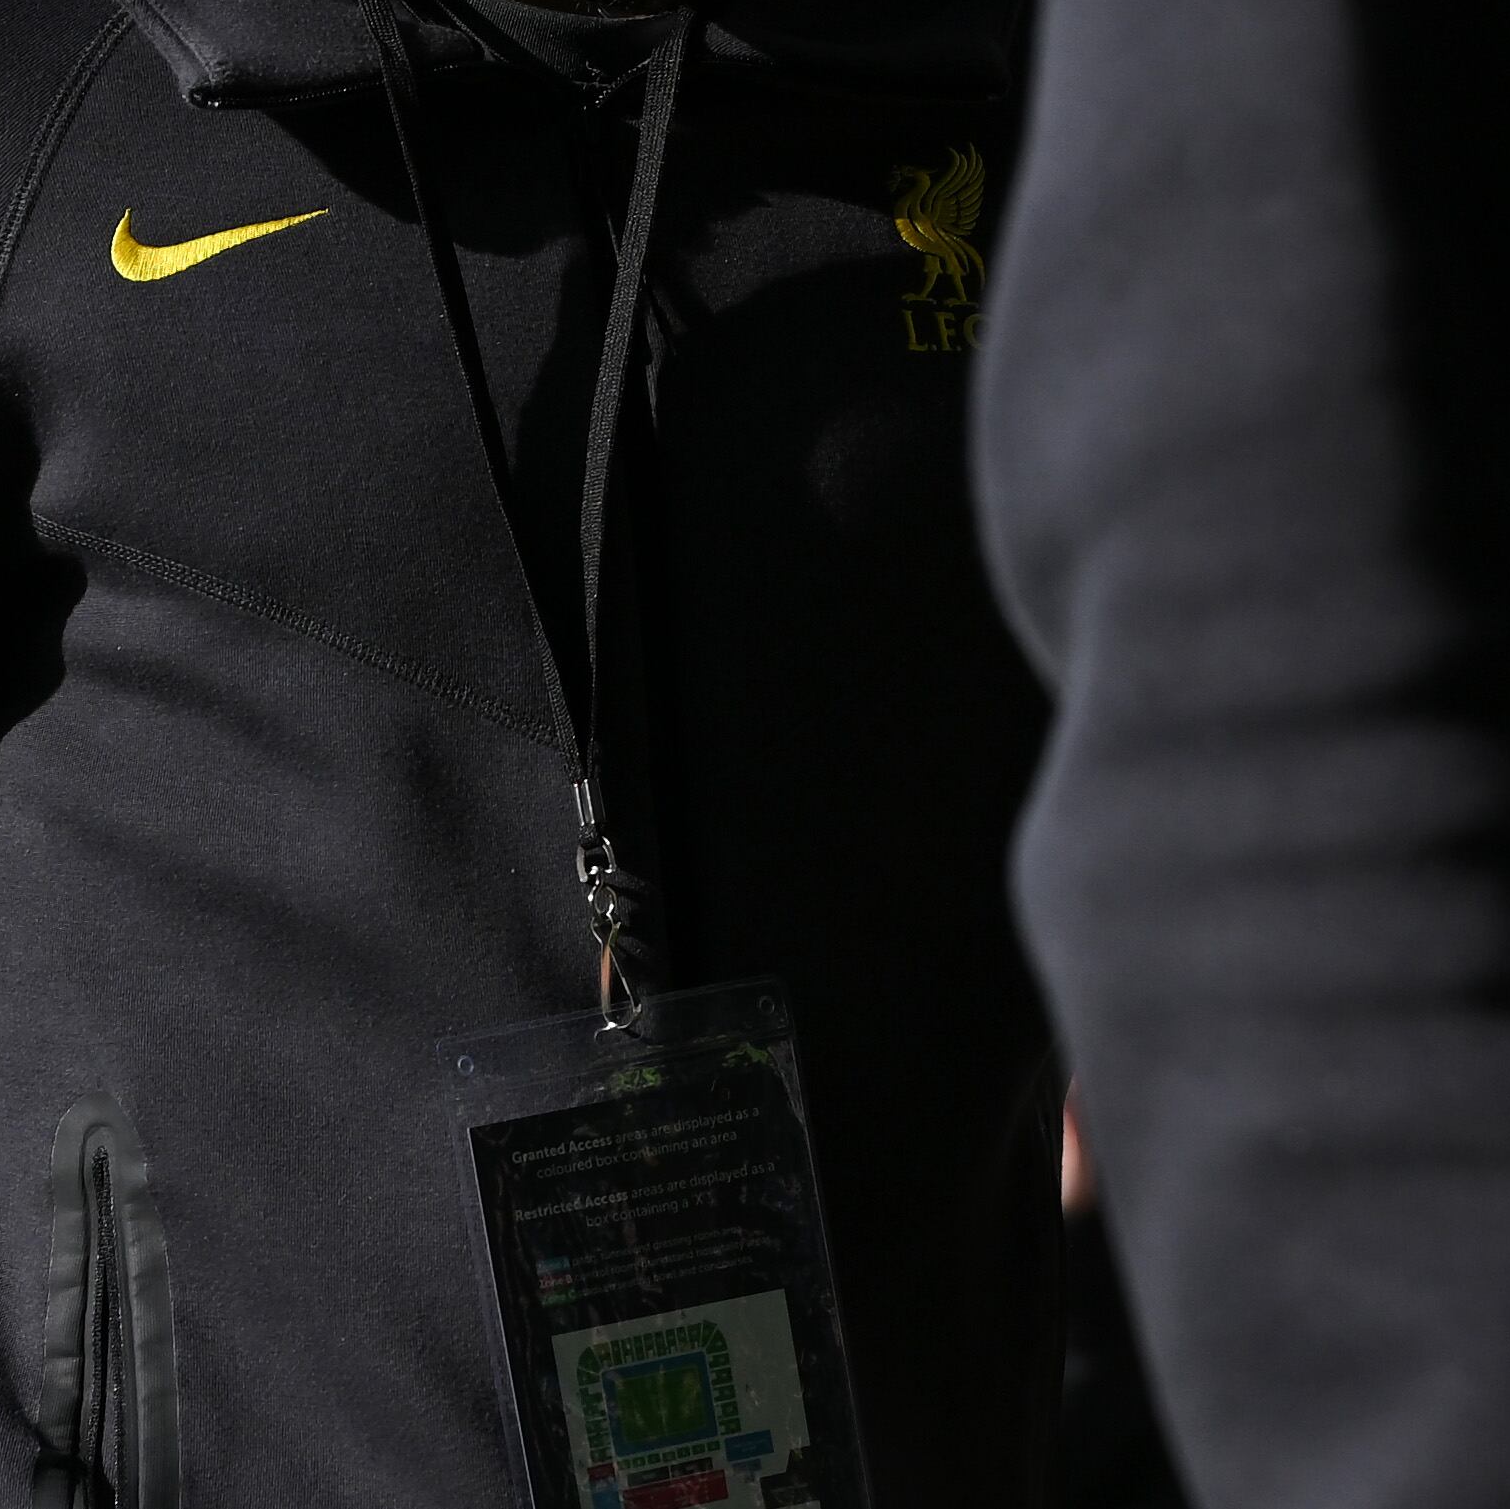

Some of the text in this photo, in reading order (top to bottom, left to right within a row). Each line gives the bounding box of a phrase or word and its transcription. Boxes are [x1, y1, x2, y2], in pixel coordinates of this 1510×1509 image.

[511, 1106, 761, 1164] Granted Access areas are displayed as a
[536, 1130, 738, 1180] coloured box containing an area
[514, 1161, 776, 1222] Restricted Access areas are displayed as a
[585, 1213, 610, 1228] box
[611, 1198, 679, 1223] containing
